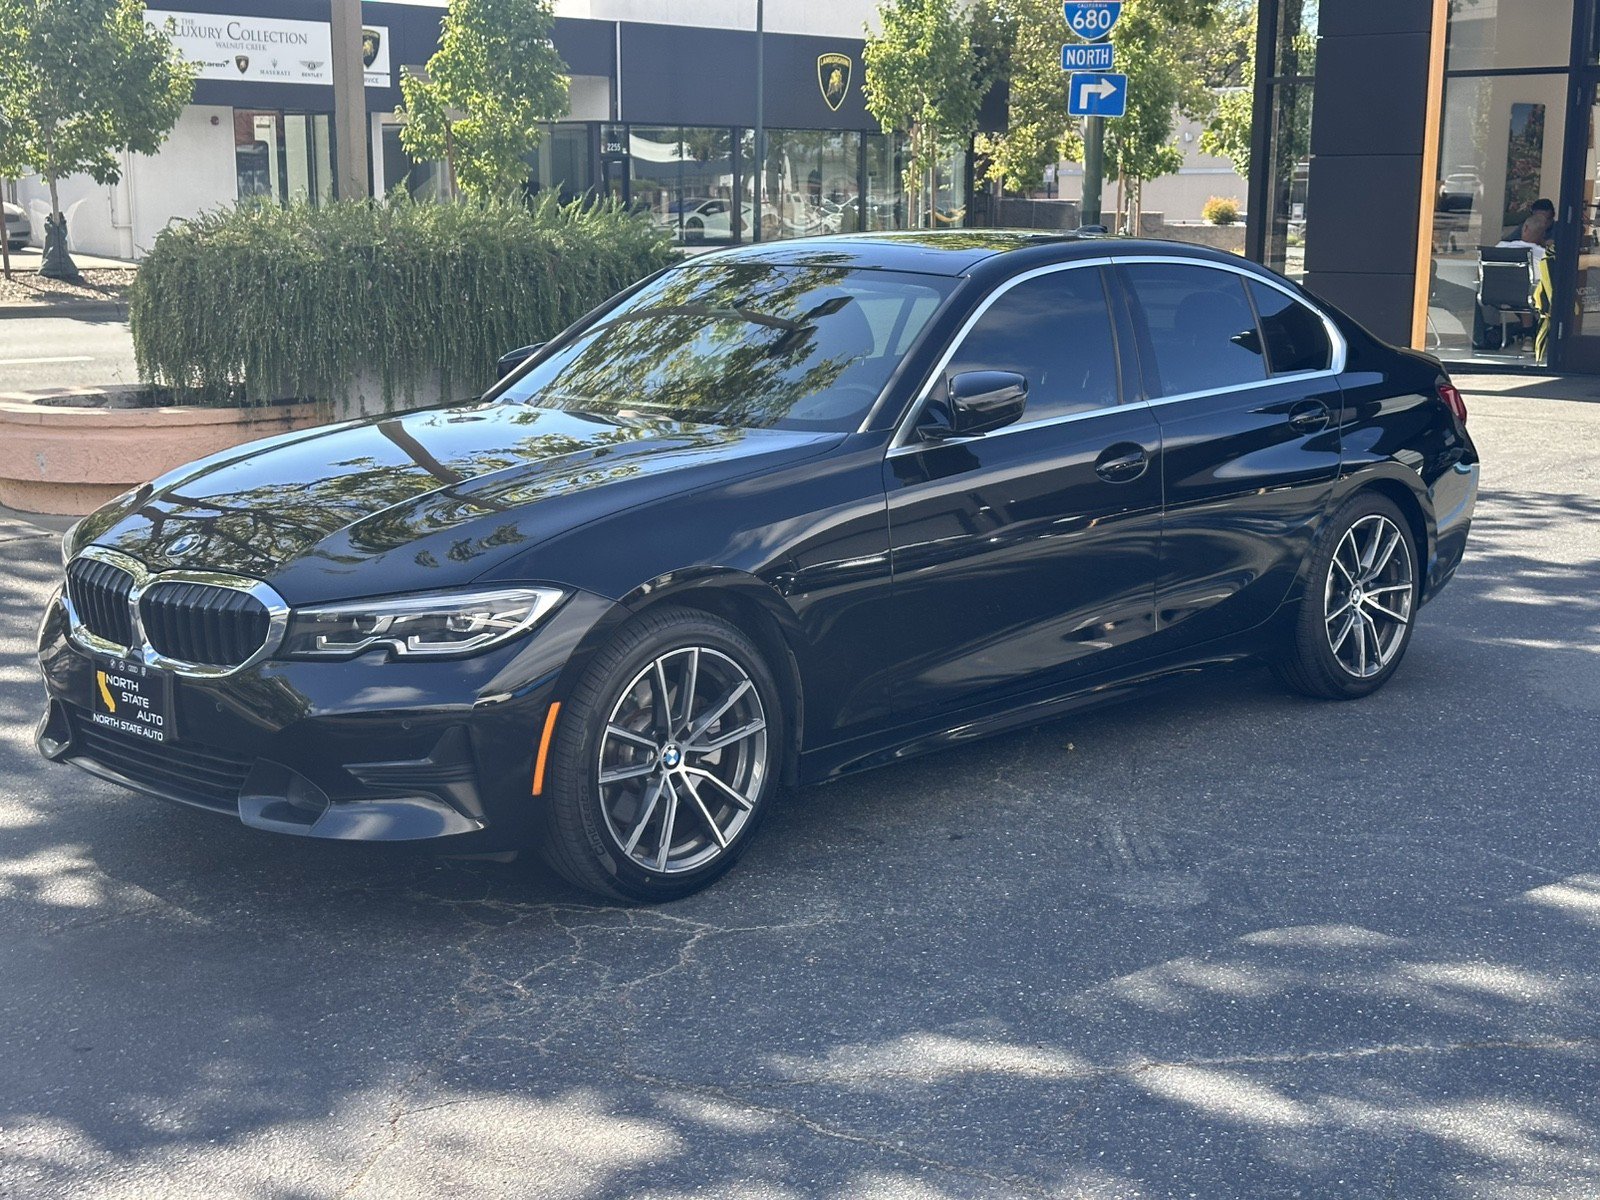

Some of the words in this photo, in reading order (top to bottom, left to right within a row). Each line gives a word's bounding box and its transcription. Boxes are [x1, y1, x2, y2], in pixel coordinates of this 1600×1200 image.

[181, 17, 194, 26] THE
[1073, 9, 1111, 30] 680
[173, 24, 222, 40] LUXURY
[226, 21, 308, 45] COLLECTION
[215, 41, 245, 51] WALNUT
[246, 43, 267, 52] CREEK
[1066, 48, 1110, 66] NORTH
[259, 69, 291, 77] MASERATI
[105, 673, 139, 692] NORTH
[121, 691, 149, 709] STATE
[136, 709, 164, 726] AUTO
[92, 712, 120, 728] NORTH
[120, 720, 142, 735] STATE
[142, 727, 164, 742] AUTO
